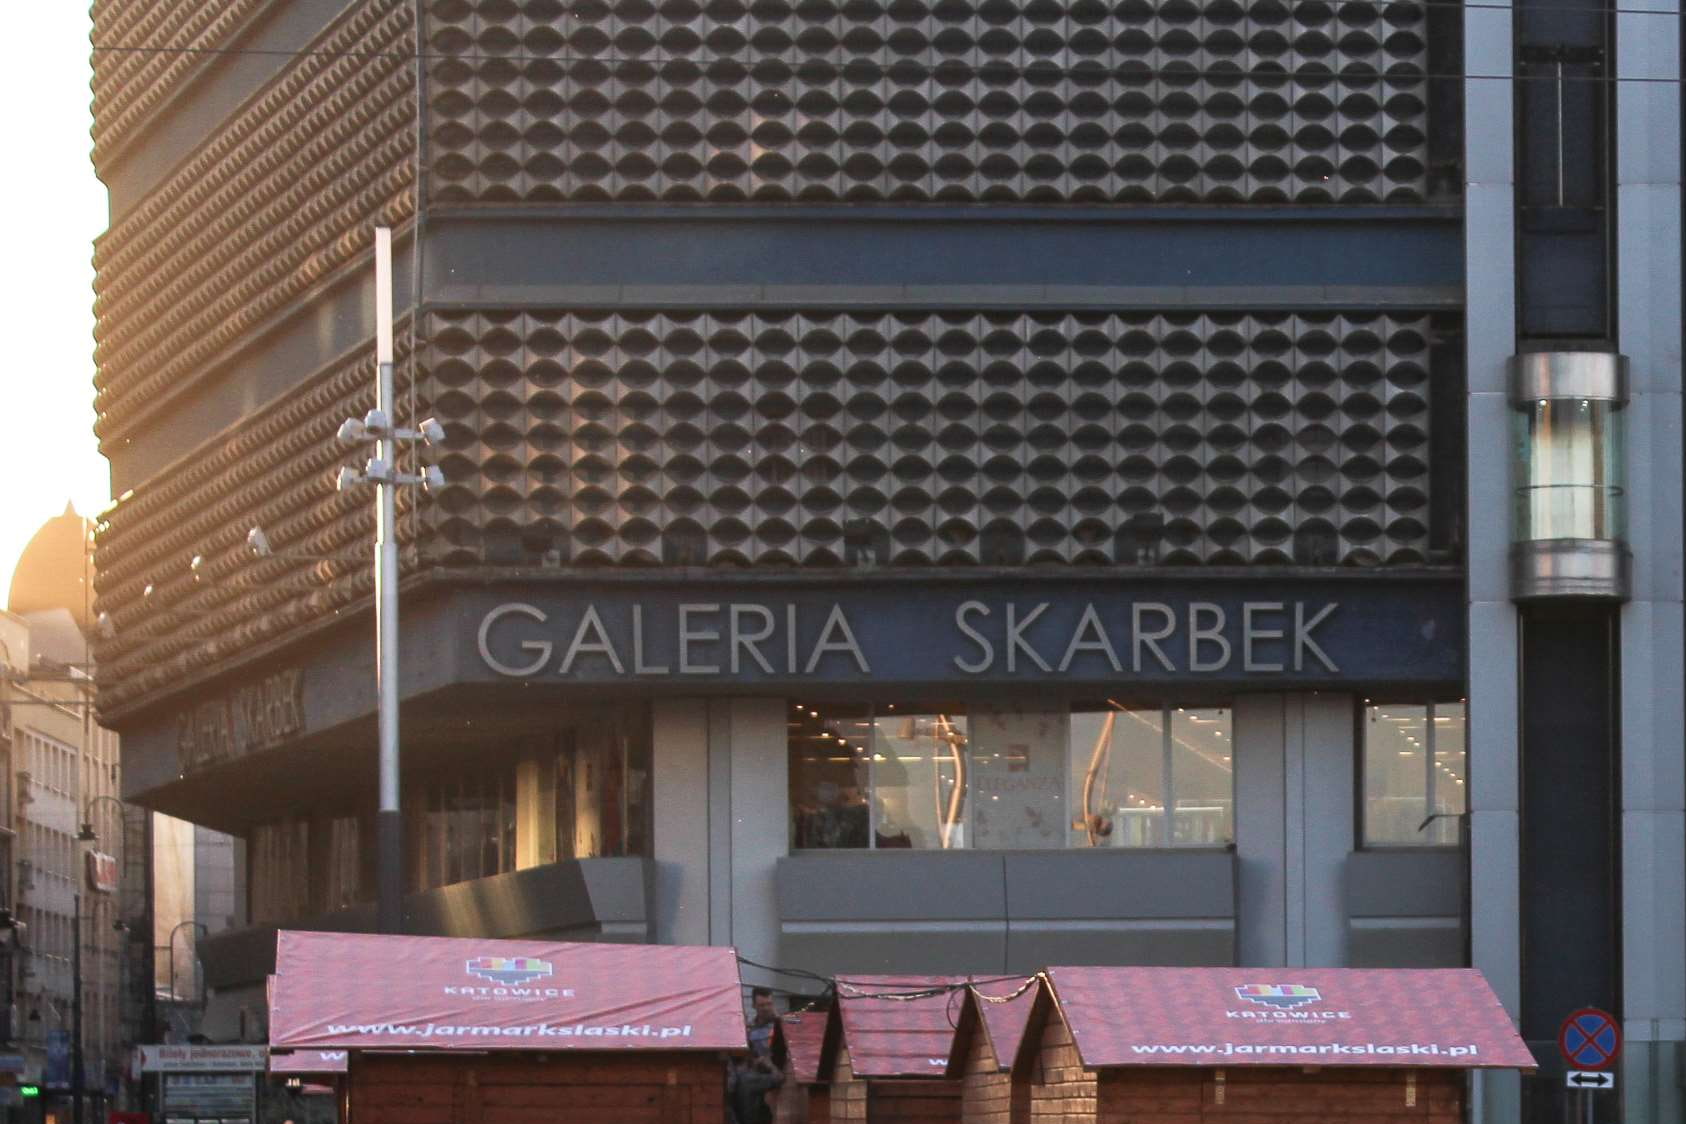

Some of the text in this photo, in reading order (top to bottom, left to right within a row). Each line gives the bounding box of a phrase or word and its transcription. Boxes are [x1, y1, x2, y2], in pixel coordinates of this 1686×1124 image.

[477, 599, 1341, 677] GALERIA SKARBEK
[444, 986, 576, 997] KATOWICE
[1226, 1010, 1352, 1019] KATOWICE
[327, 1022, 692, 1037] www.jarmarkslaski.pl
[1131, 1042, 1477, 1056] www.jarmarkslaski.pl
